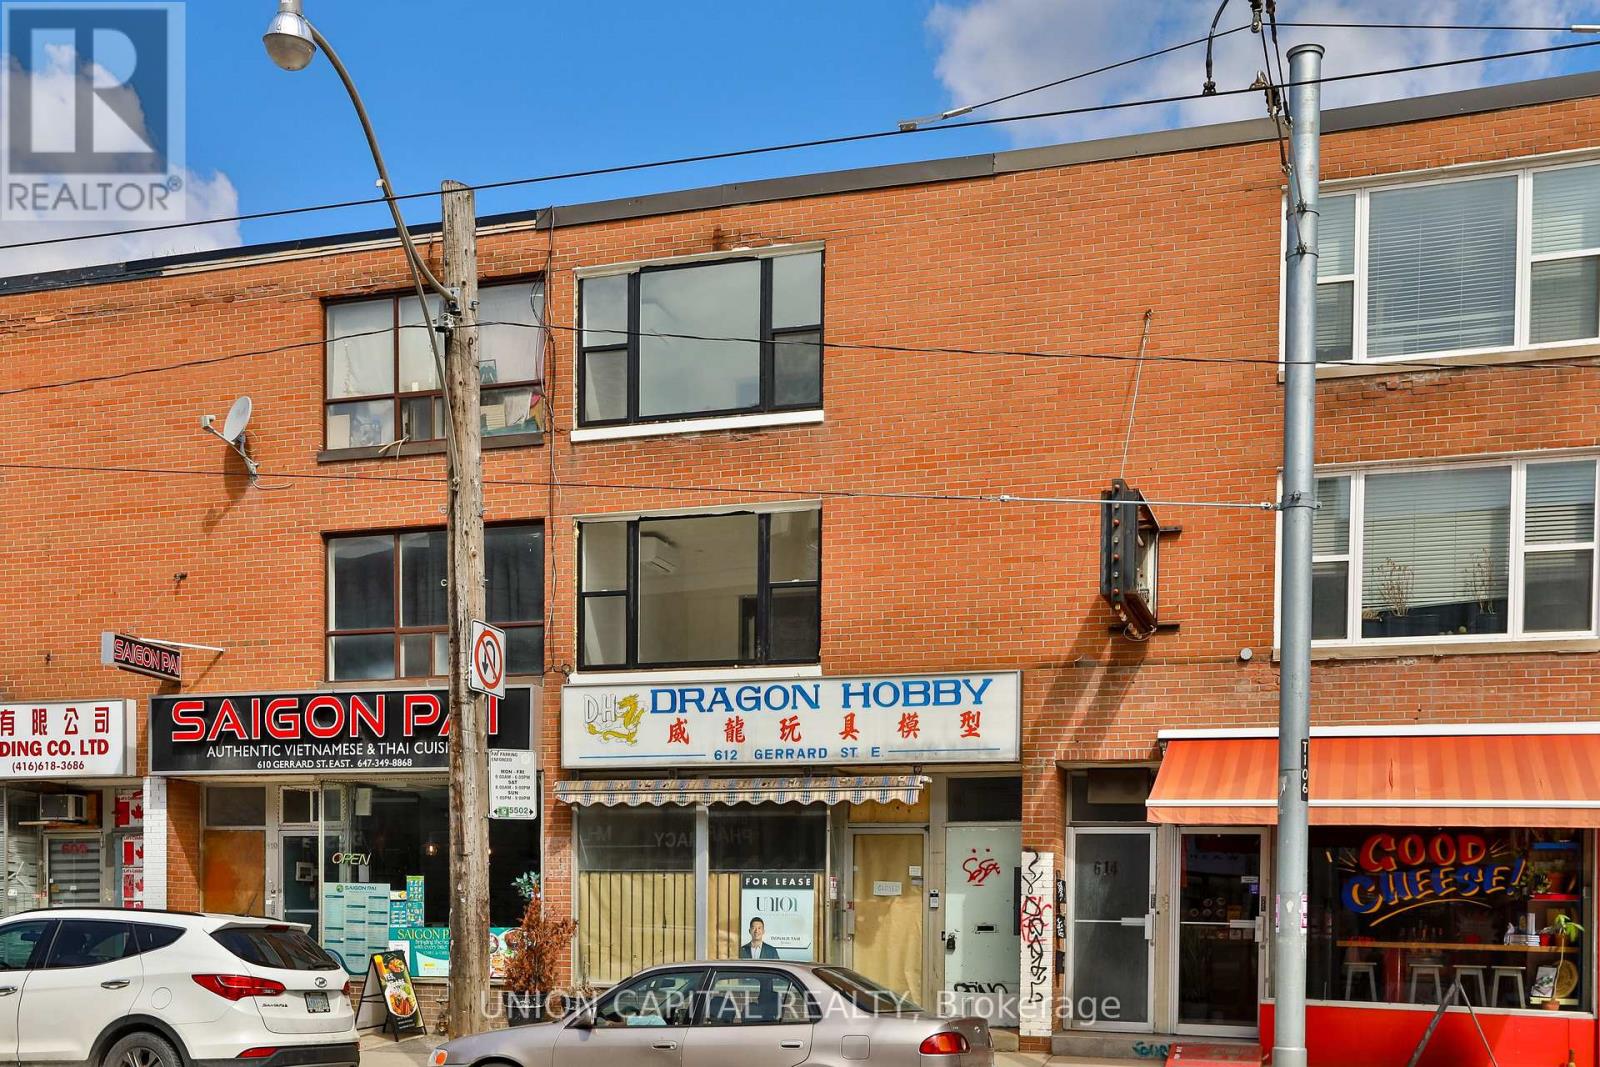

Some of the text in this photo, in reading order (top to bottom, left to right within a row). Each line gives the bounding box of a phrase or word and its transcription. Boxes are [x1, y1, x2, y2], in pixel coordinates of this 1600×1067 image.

[114, 639, 181, 676] SAIGON PAI
[650, 678, 993, 714] DRAGON HOBBY
[0, 706, 110, 737] 有限公司
[172, 693, 499, 742] SAIGON PI
[667, 710, 981, 745] 威龍玩具模型
[47, 740, 75, 757] CO.
[80, 739, 109, 755] LTD
[206, 741, 449, 758] AUTHENTIC VIETNAMESE & THAI CUISI
[714, 750, 737, 761] 612
[754, 747, 827, 760] GERRARD
[12, 761, 85, 773] (416)618-3686
[257, 760, 271, 769] 610
[273, 759, 314, 769] GERRARD
[357, 758, 413, 768] 647-349-8868
[509, 806, 529, 815] 5502
[332, 852, 372, 866] OPEN
[1360, 833, 1487, 873] GOOD
[745, 877, 811, 886] FOR LEASE
[1341, 855, 1528, 914] CHEESE!
[397, 928, 440, 940] SAIGON
